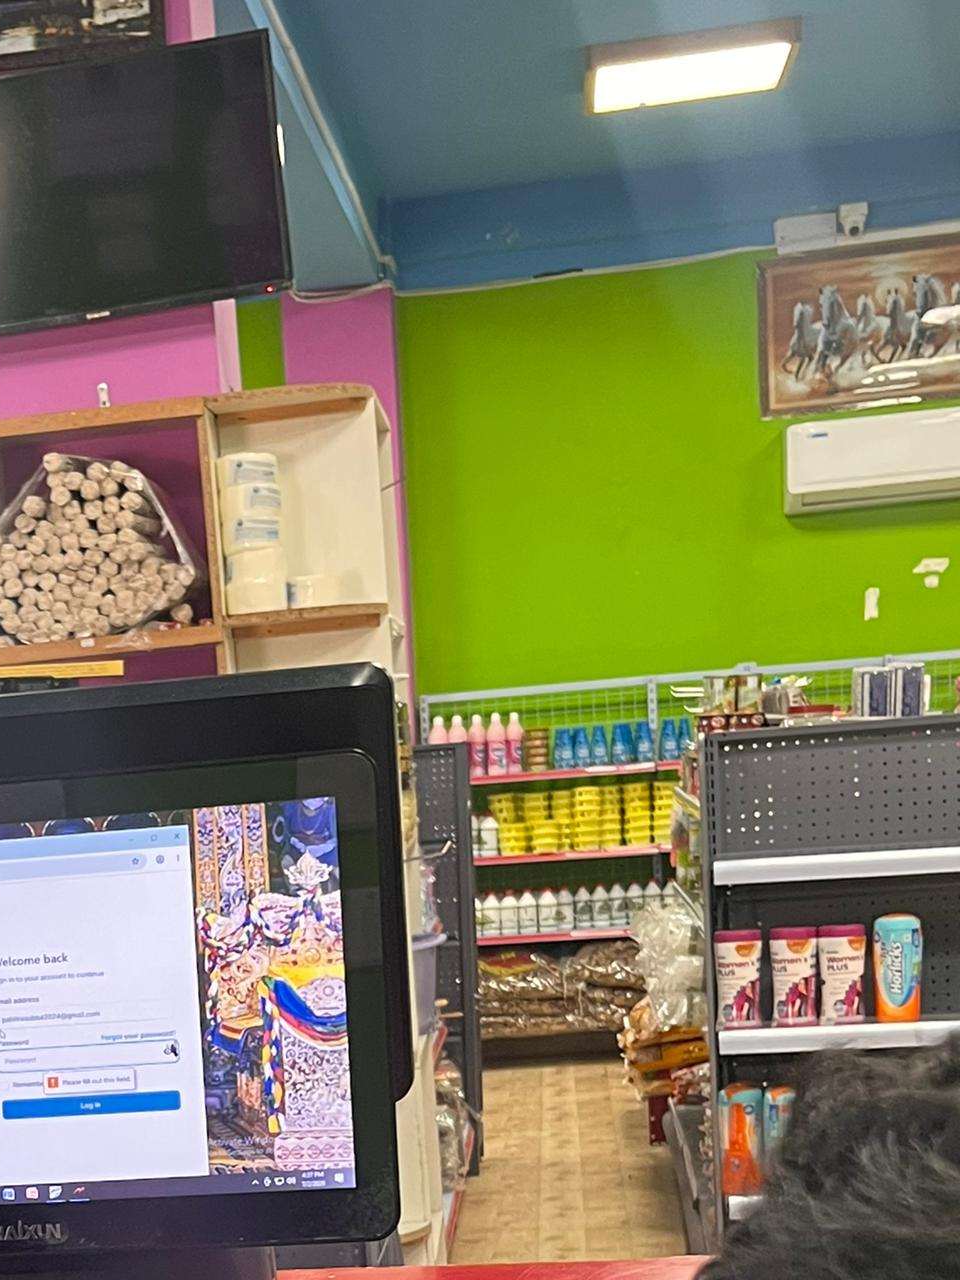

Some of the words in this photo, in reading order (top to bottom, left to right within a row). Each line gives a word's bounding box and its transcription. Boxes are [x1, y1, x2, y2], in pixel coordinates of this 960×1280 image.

[43, 951, 68, 964] back
[826, 963, 849, 971] PLUS
[889, 941, 903, 995] Horlicks
[24, 974, 39, 983] your
[13, 996, 40, 1005] address
[80, 1101, 94, 1110] Log
